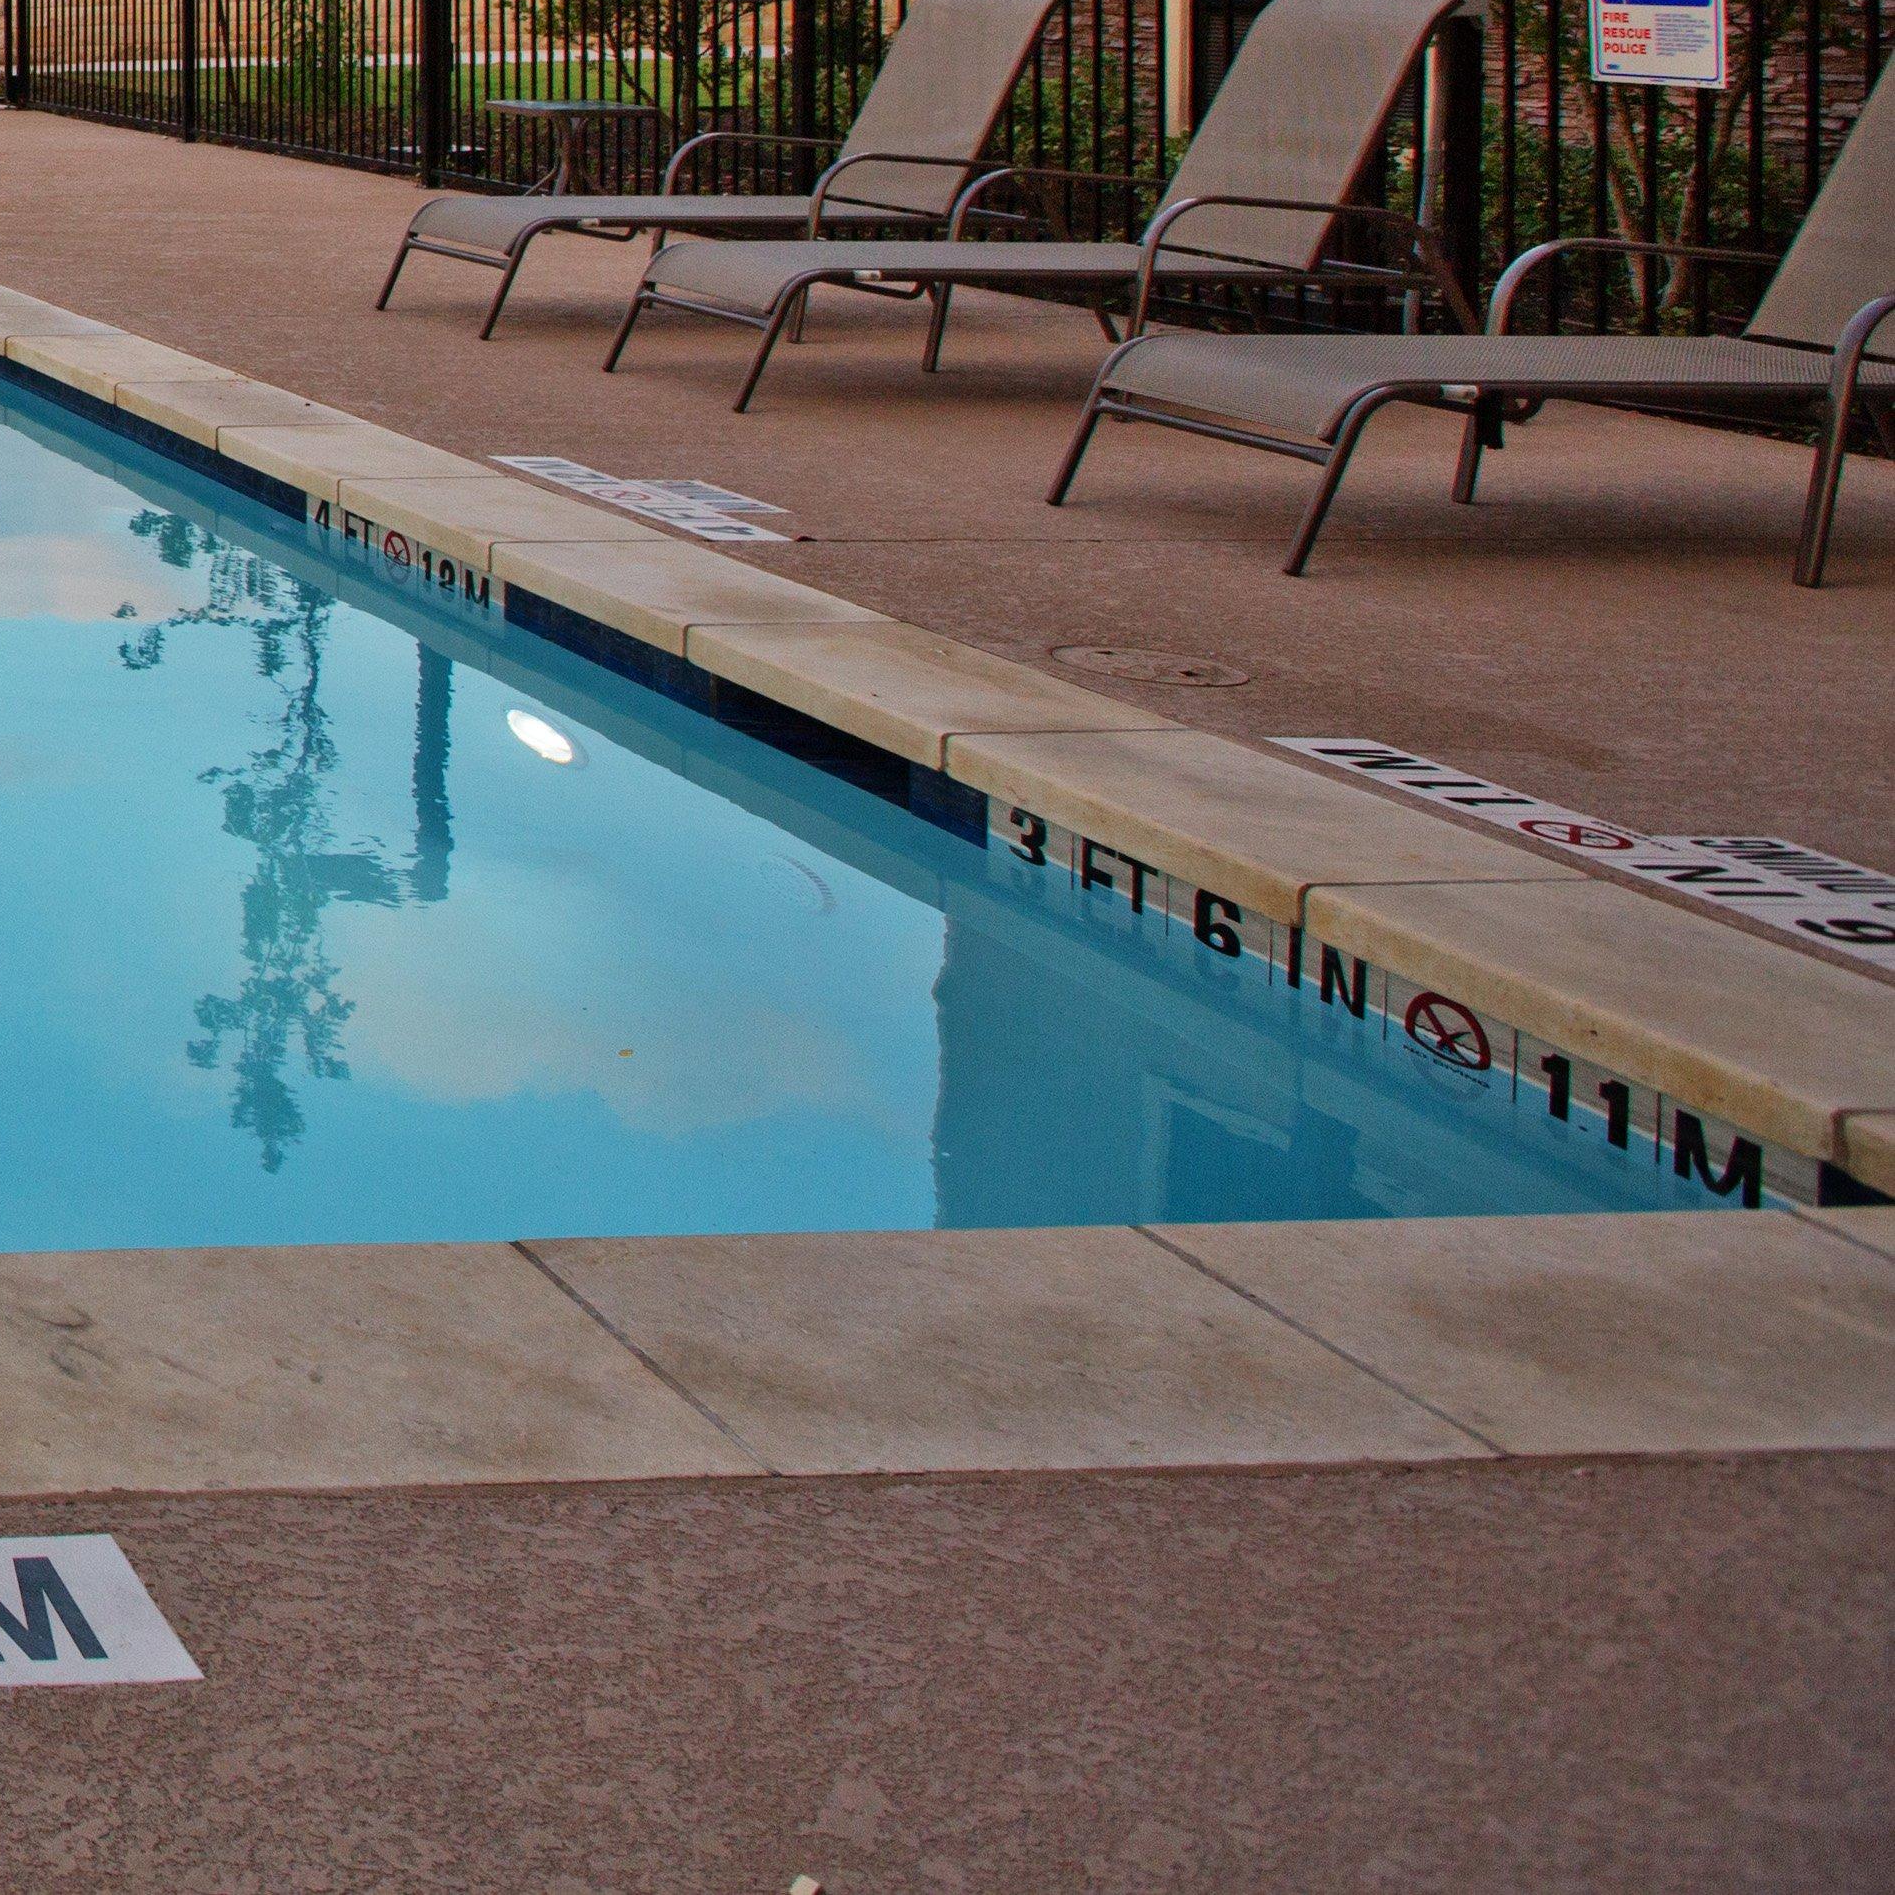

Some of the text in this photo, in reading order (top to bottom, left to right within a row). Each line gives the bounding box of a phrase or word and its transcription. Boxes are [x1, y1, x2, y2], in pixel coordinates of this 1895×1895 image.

[1602, 12, 1629, 23] FIRE
[1603, 28, 1651, 39] RESCUE
[1604, 43, 1647, 55] POLICE
[314, 499, 331, 531] 4
[343, 509, 375, 550] FT
[465, 569, 491, 610] M
[1311, 747, 1442, 771] M
[1633, 863, 1806, 899] IN
[1009, 806, 1048, 867] 3
[1081, 836, 1160, 916] FT
[1193, 887, 1242, 958] 6
[1287, 925, 1367, 1021] IN
[1673, 1108, 1763, 1209] M
